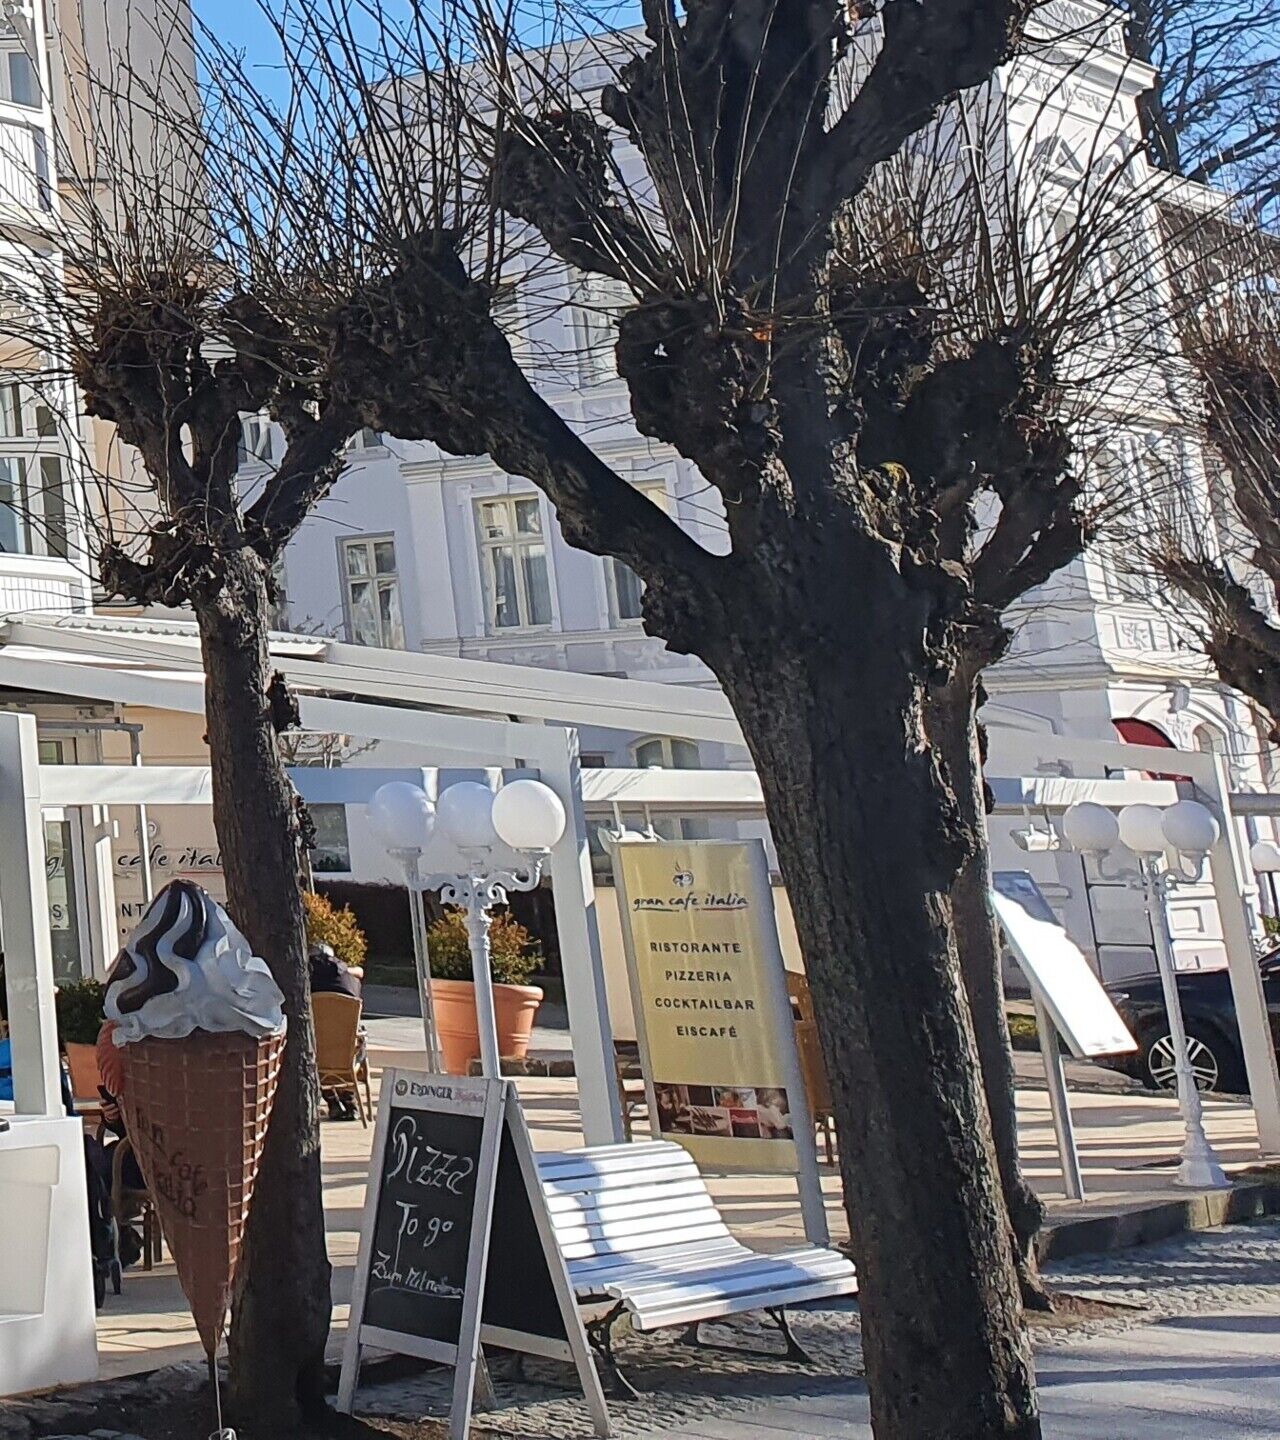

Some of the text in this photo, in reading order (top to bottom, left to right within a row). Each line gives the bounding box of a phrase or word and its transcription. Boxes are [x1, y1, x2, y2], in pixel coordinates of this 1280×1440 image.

[633, 892, 748, 910] gran cafe italia
[650, 942, 741, 954] RISTORANTE
[665, 970, 732, 982] PIZZERIA
[654, 997, 755, 1010] COCKTAILBAR
[676, 1025, 738, 1038] EISCAFÉ
[387, 1115, 474, 1195] Pizza
[396, 1200, 454, 1247] To go
